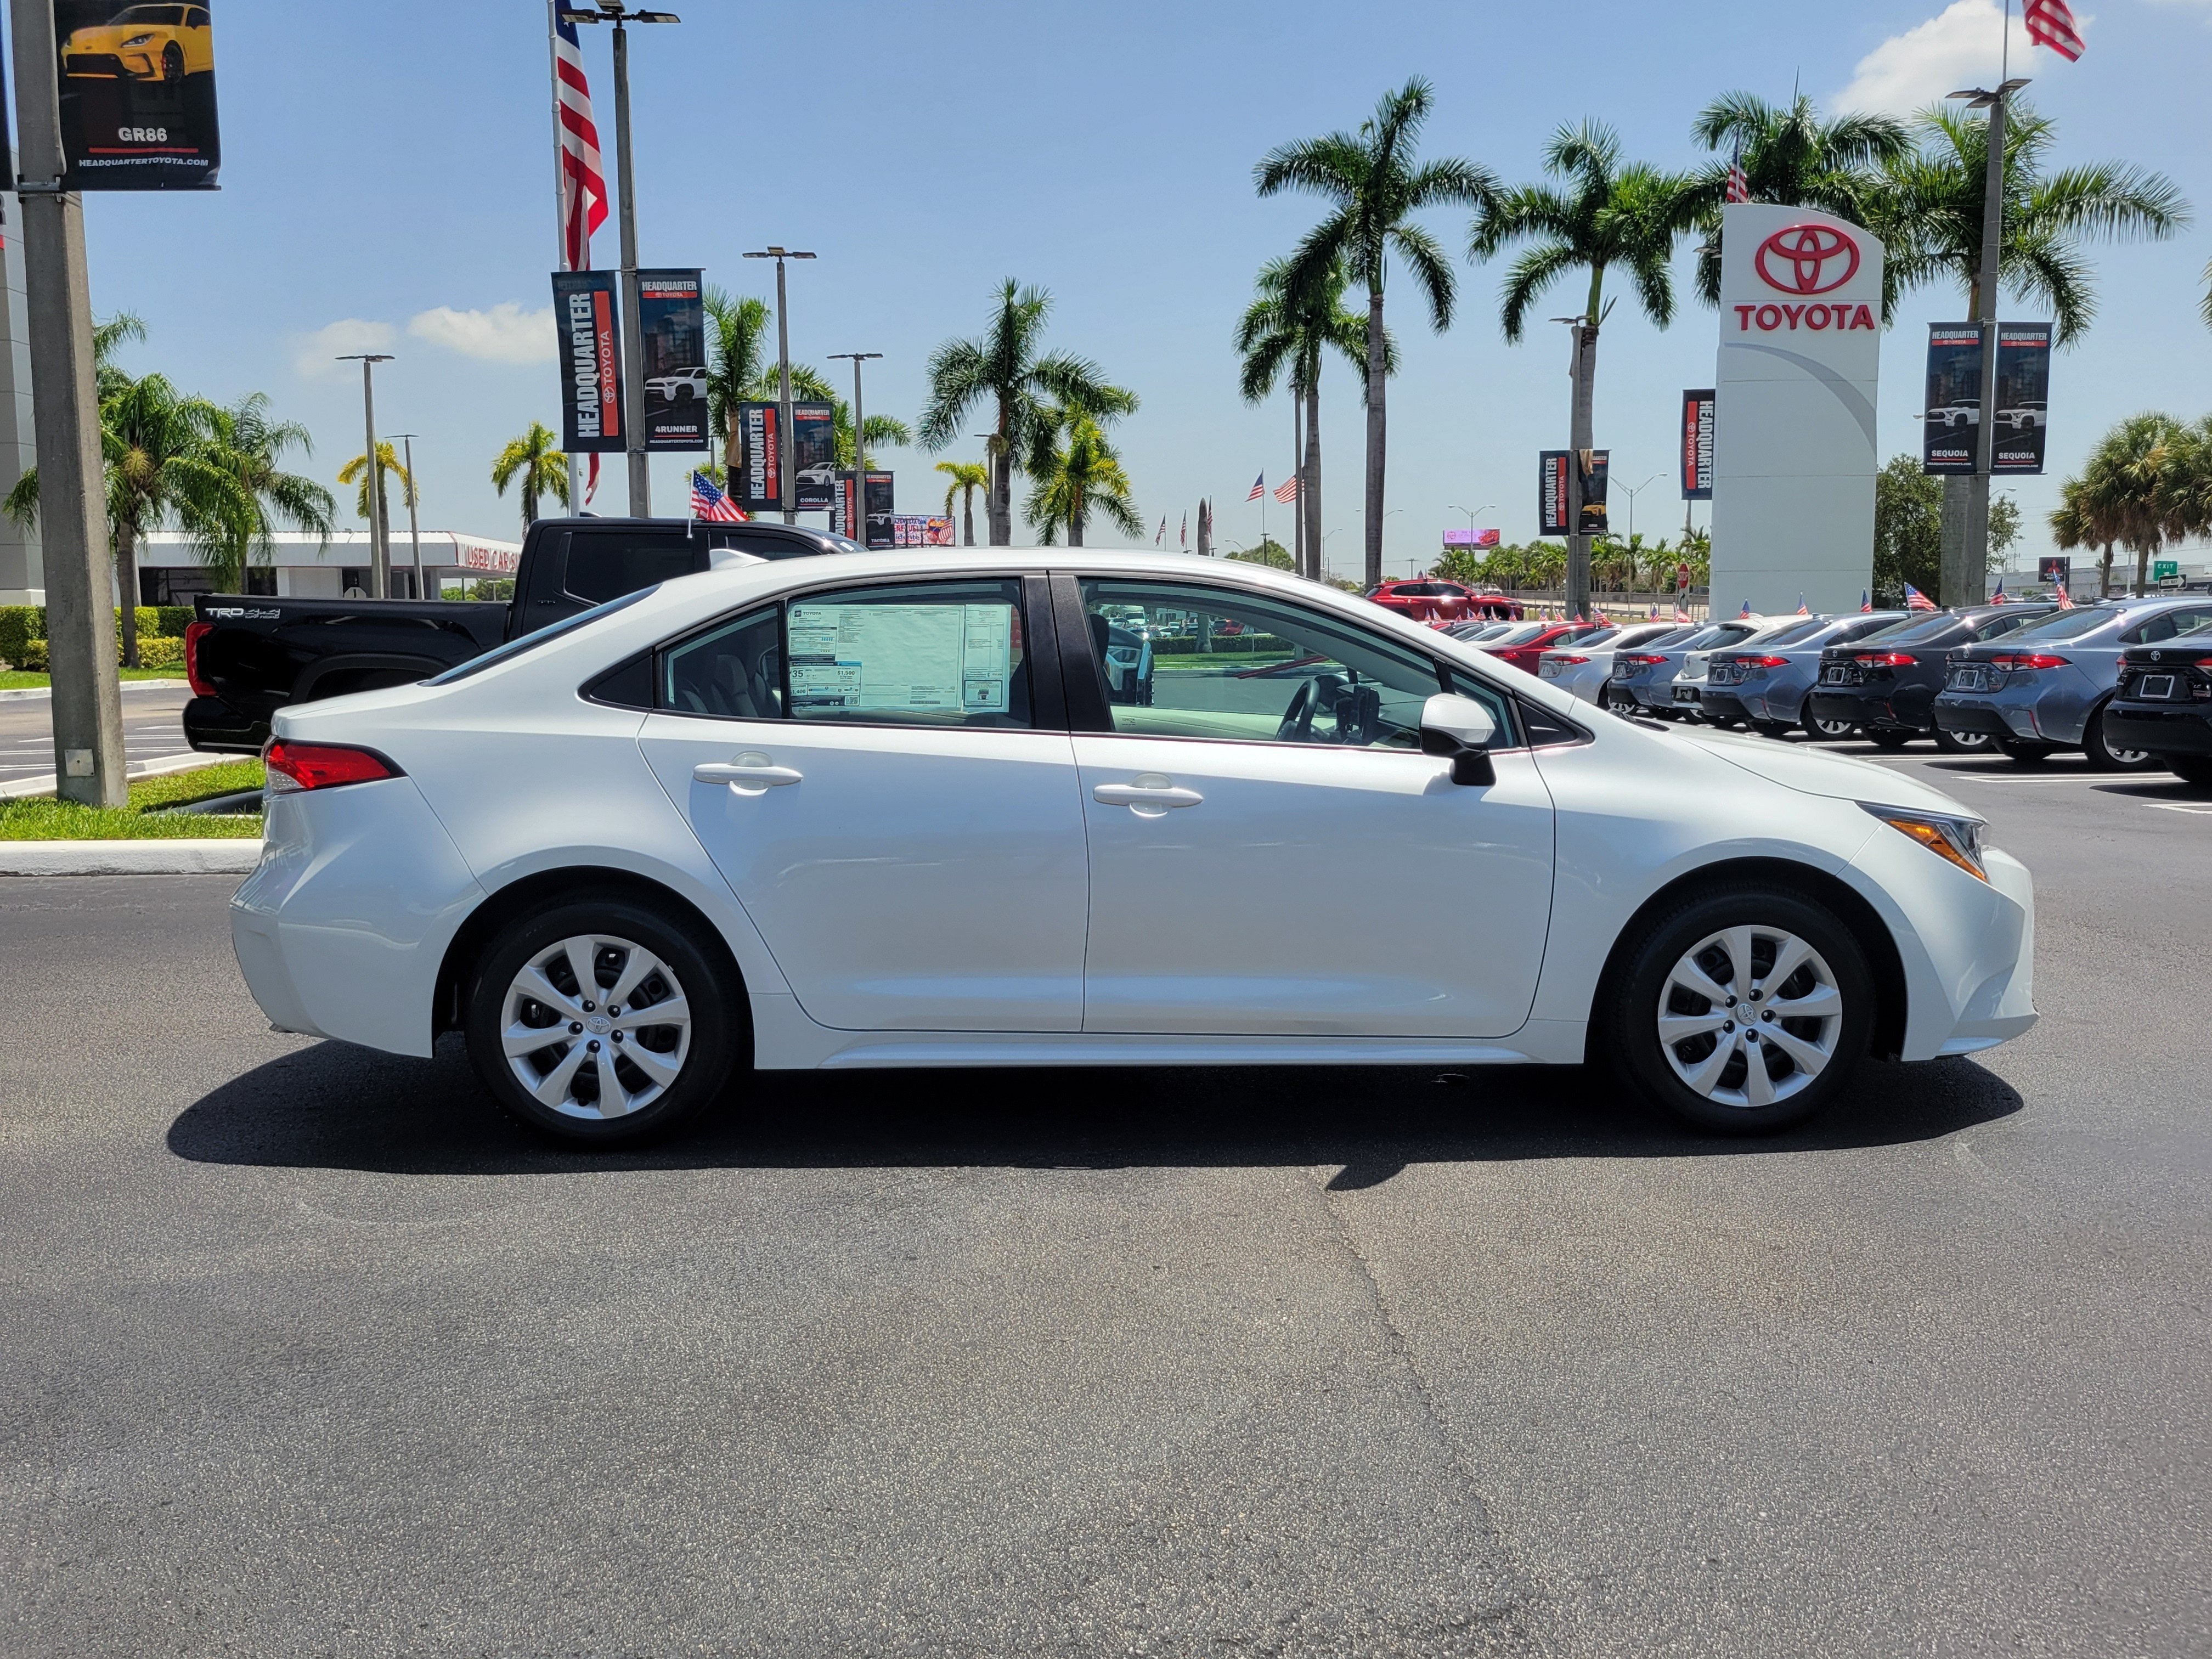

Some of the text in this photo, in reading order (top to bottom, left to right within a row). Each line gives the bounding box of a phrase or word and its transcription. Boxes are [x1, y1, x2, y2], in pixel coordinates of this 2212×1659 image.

[118, 127, 167, 142] GR86
[79, 157, 208, 167] HEADQUARTERTOYOTA.COM
[642, 281, 697, 292] HEADQUARTER
[1734, 304, 1875, 330] TOYOTA
[1932, 330, 1978, 340] HEADQUARTER
[2001, 332, 2047, 341] HEADQUARTER
[569, 293, 600, 437] HEADQUARTER
[601, 331, 613, 385] TOYOTA
[749, 409, 766, 499] HEADQUARTER
[1696, 400, 1713, 489] HEADQUARTER
[1545, 458, 1558, 527] HEADQUARTER
[834, 479, 847, 536] ADQUARTER
[467, 546, 489, 567] USED
[492, 550, 509, 570] CAR
[205, 608, 244, 618] TRD
